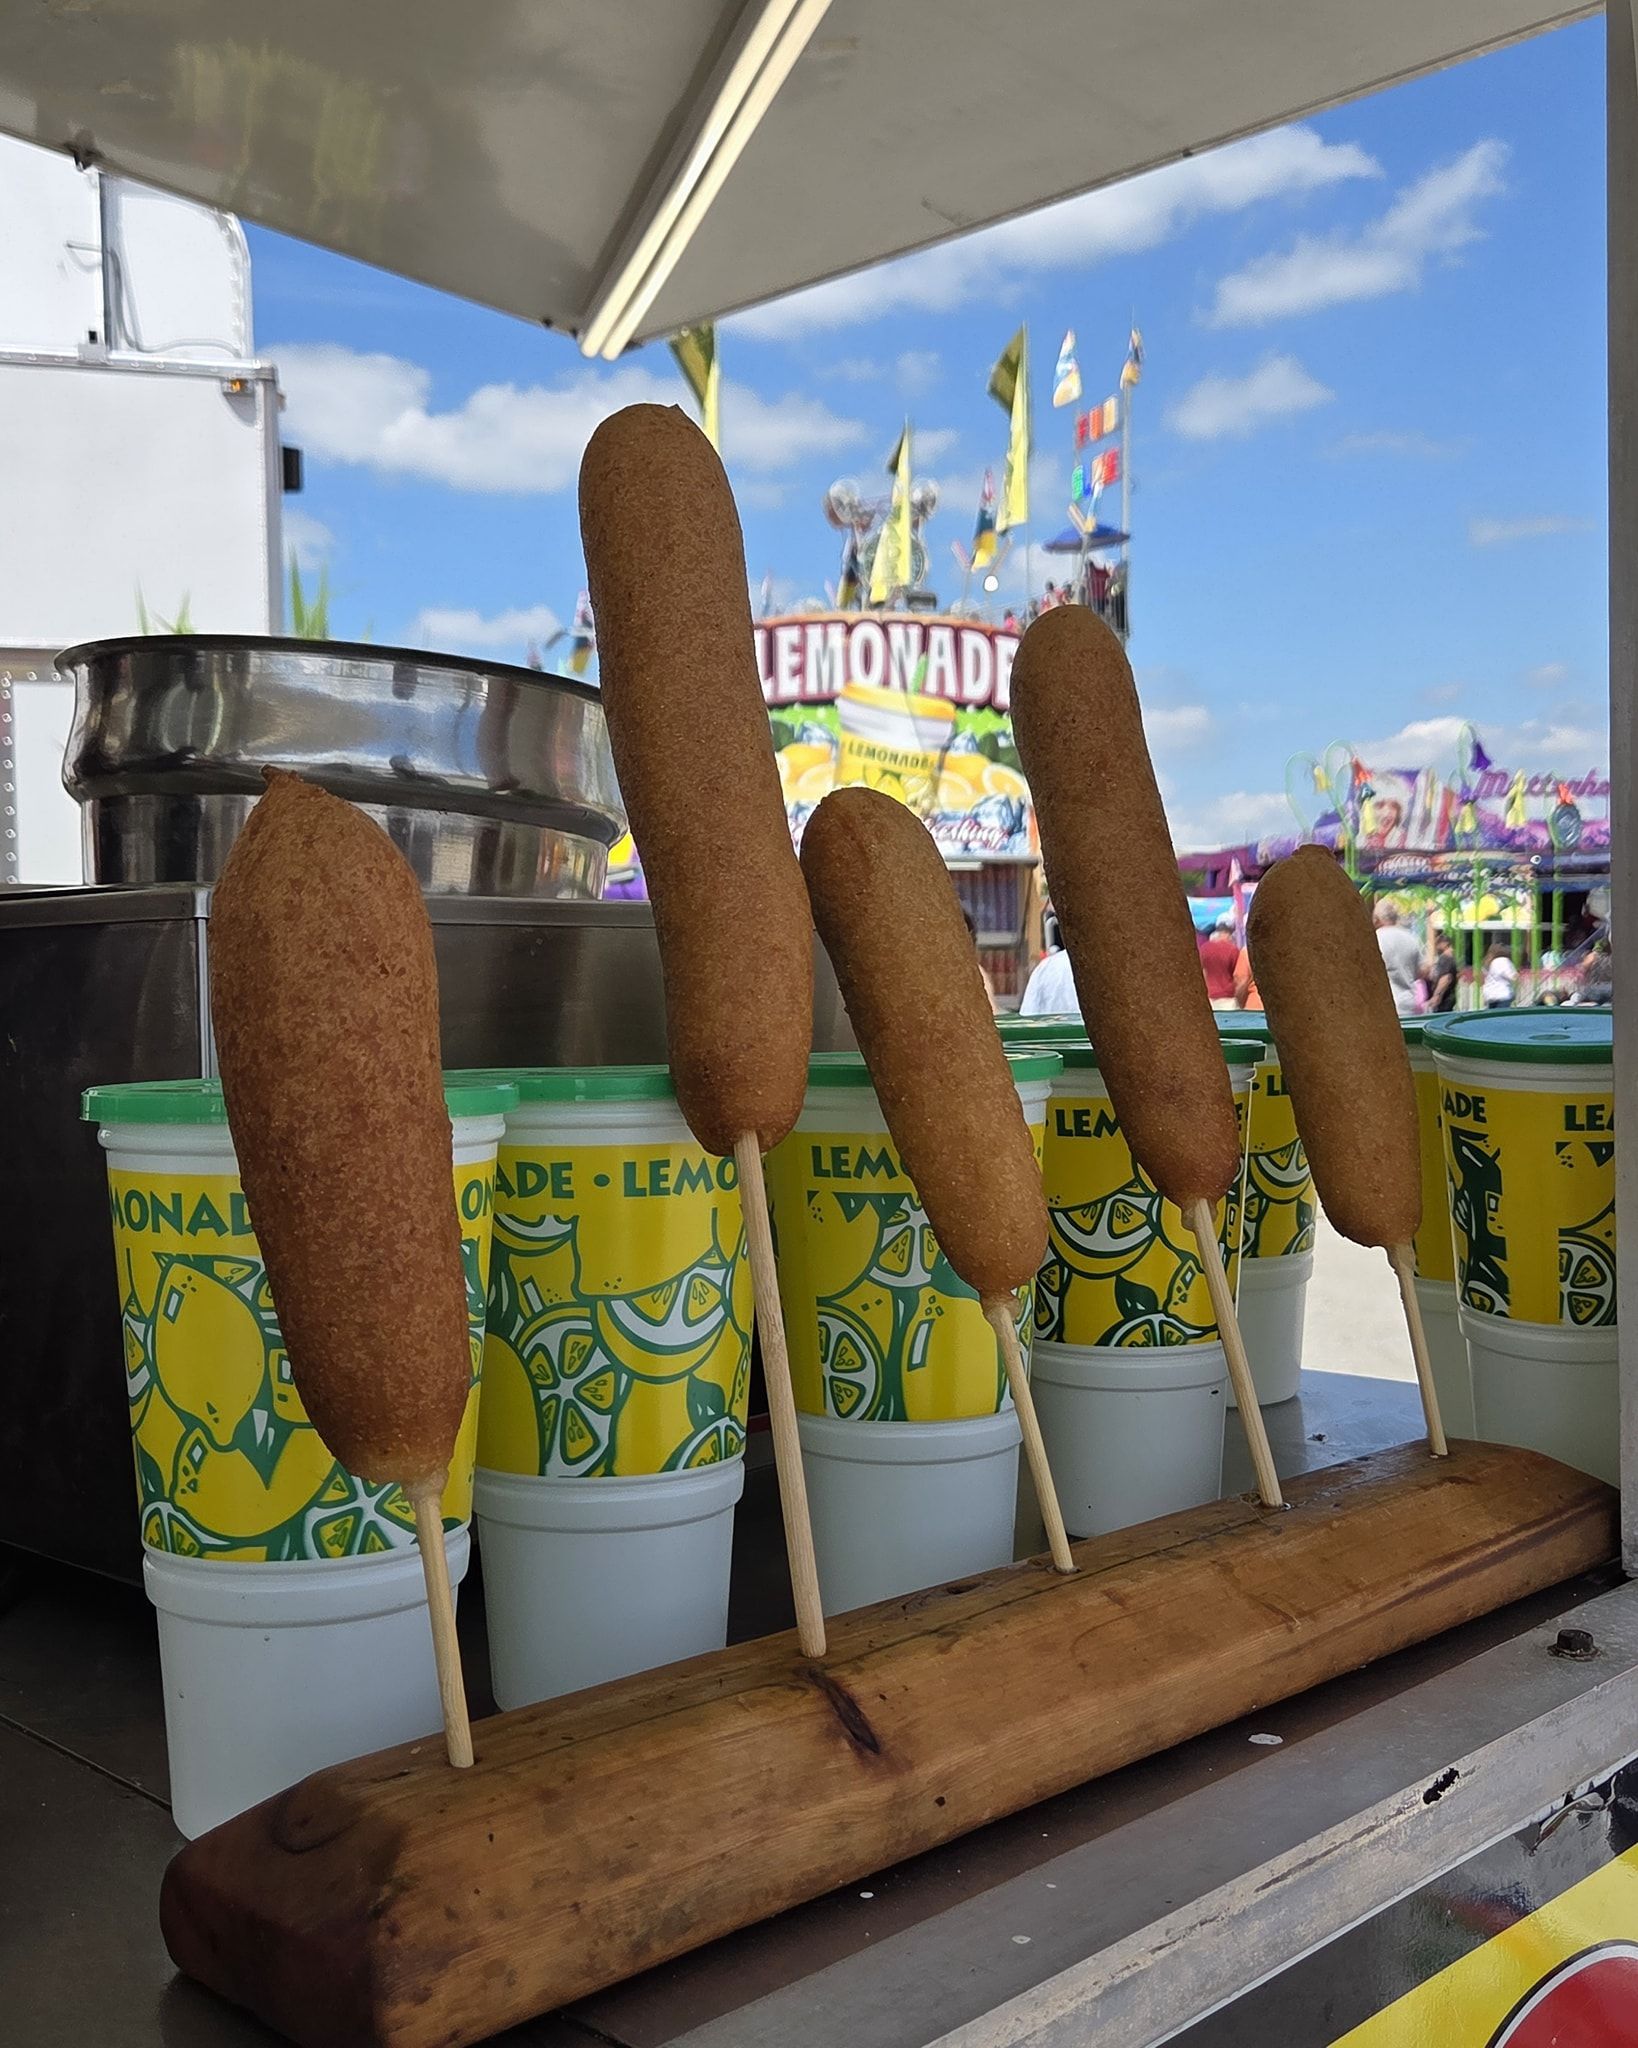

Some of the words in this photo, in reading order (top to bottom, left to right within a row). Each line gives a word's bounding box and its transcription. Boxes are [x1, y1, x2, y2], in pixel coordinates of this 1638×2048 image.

[752, 622, 1021, 708] LEMONADE
[848, 741, 930, 770] LEMONADE
[623, 1157, 739, 1198] LEMO
[811, 1145, 912, 1180] LEM
